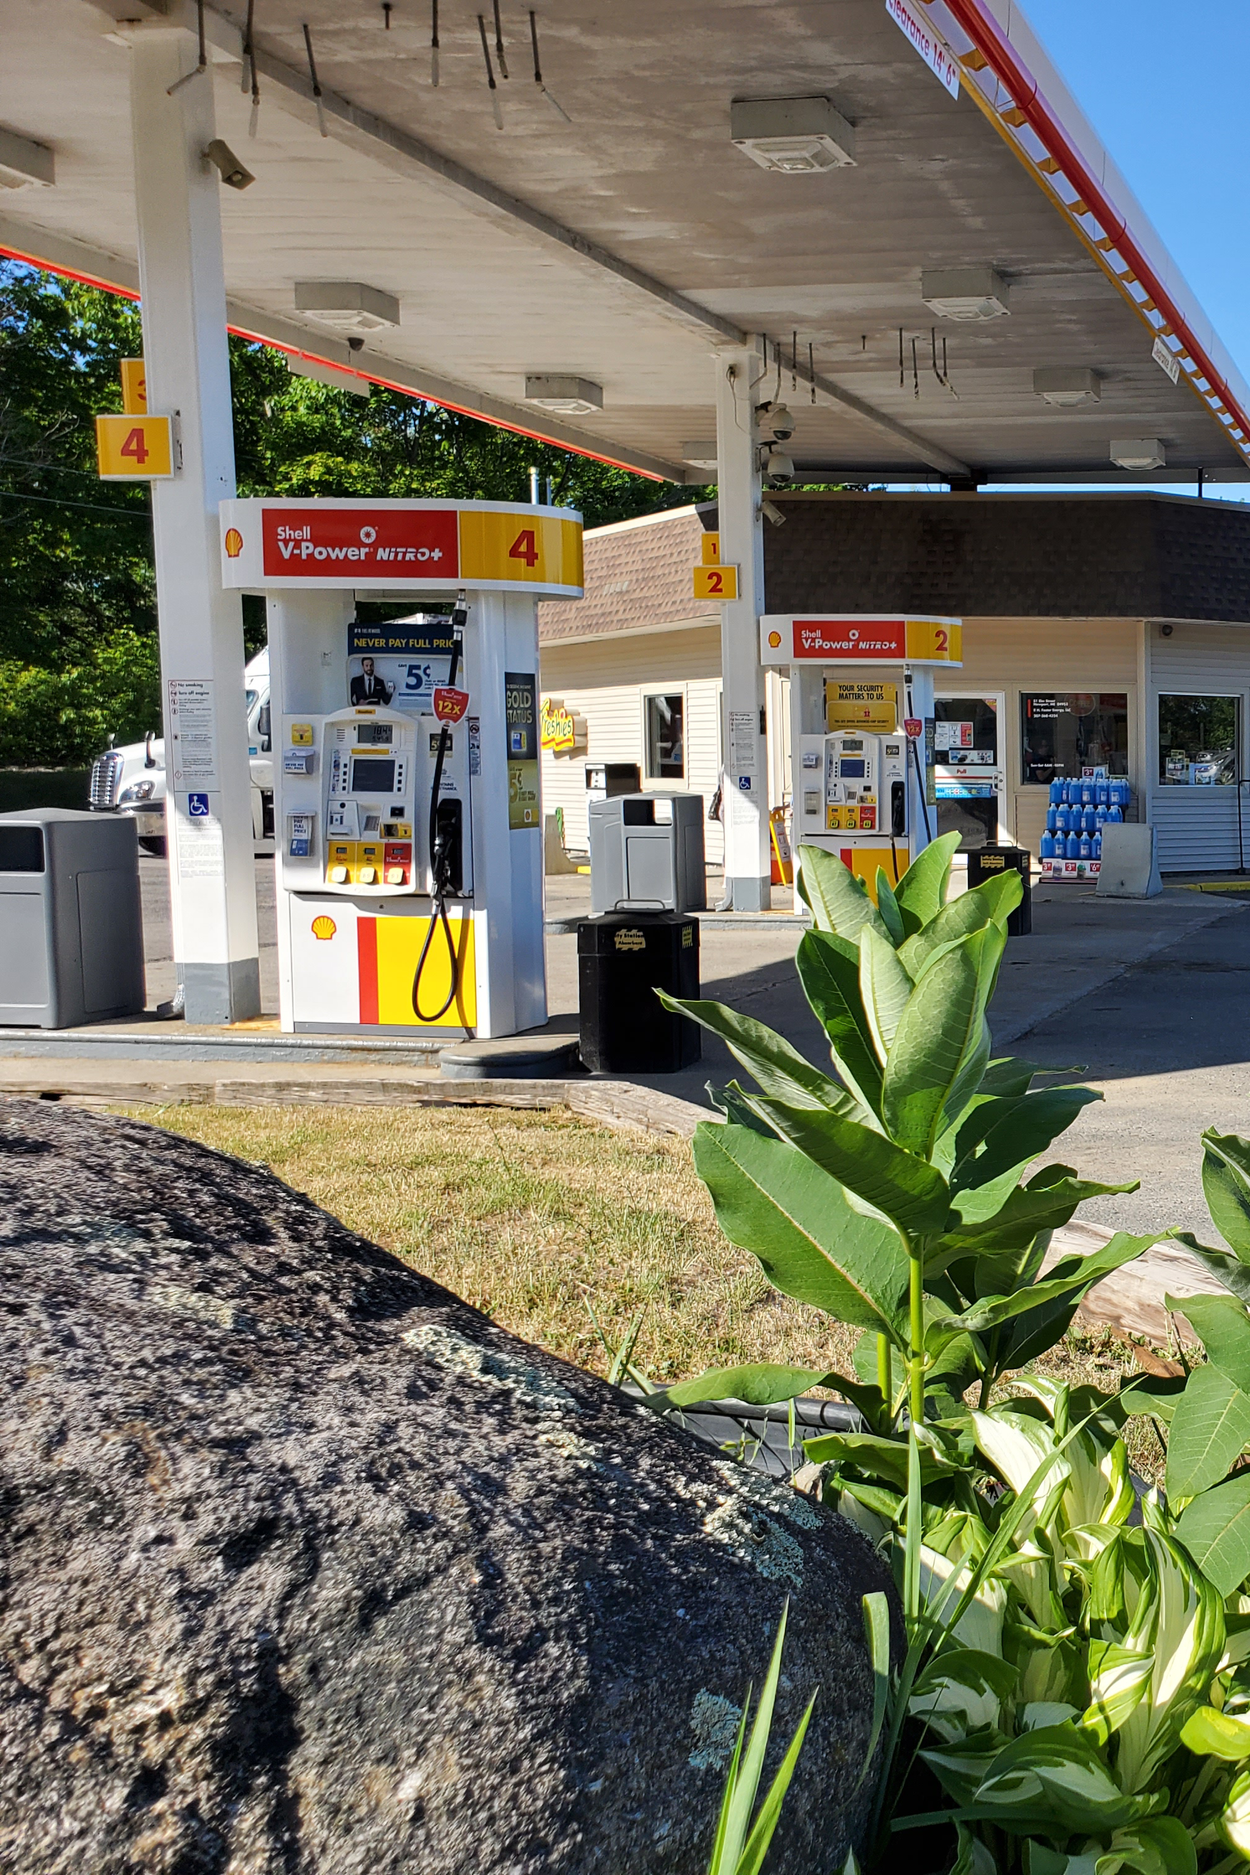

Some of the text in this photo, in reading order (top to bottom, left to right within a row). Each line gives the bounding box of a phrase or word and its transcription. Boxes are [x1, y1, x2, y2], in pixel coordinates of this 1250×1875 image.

[121, 428, 149, 464] 4
[277, 526, 311, 540] Shell
[278, 541, 370, 561] V-Power
[508, 529, 540, 567] 4
[710, 542, 717, 555] 1
[706, 571, 723, 593] 2
[801, 629, 822, 639] Shell
[934, 629, 949, 652] 2
[354, 637, 454, 648] NEVER PAY FULL PRIC
[801, 638, 854, 650] V-Power
[838, 684, 884, 692] YOUR SECURITY
[838, 692, 884, 700] MATTERS TO US
[438, 700, 461, 715] 12x
